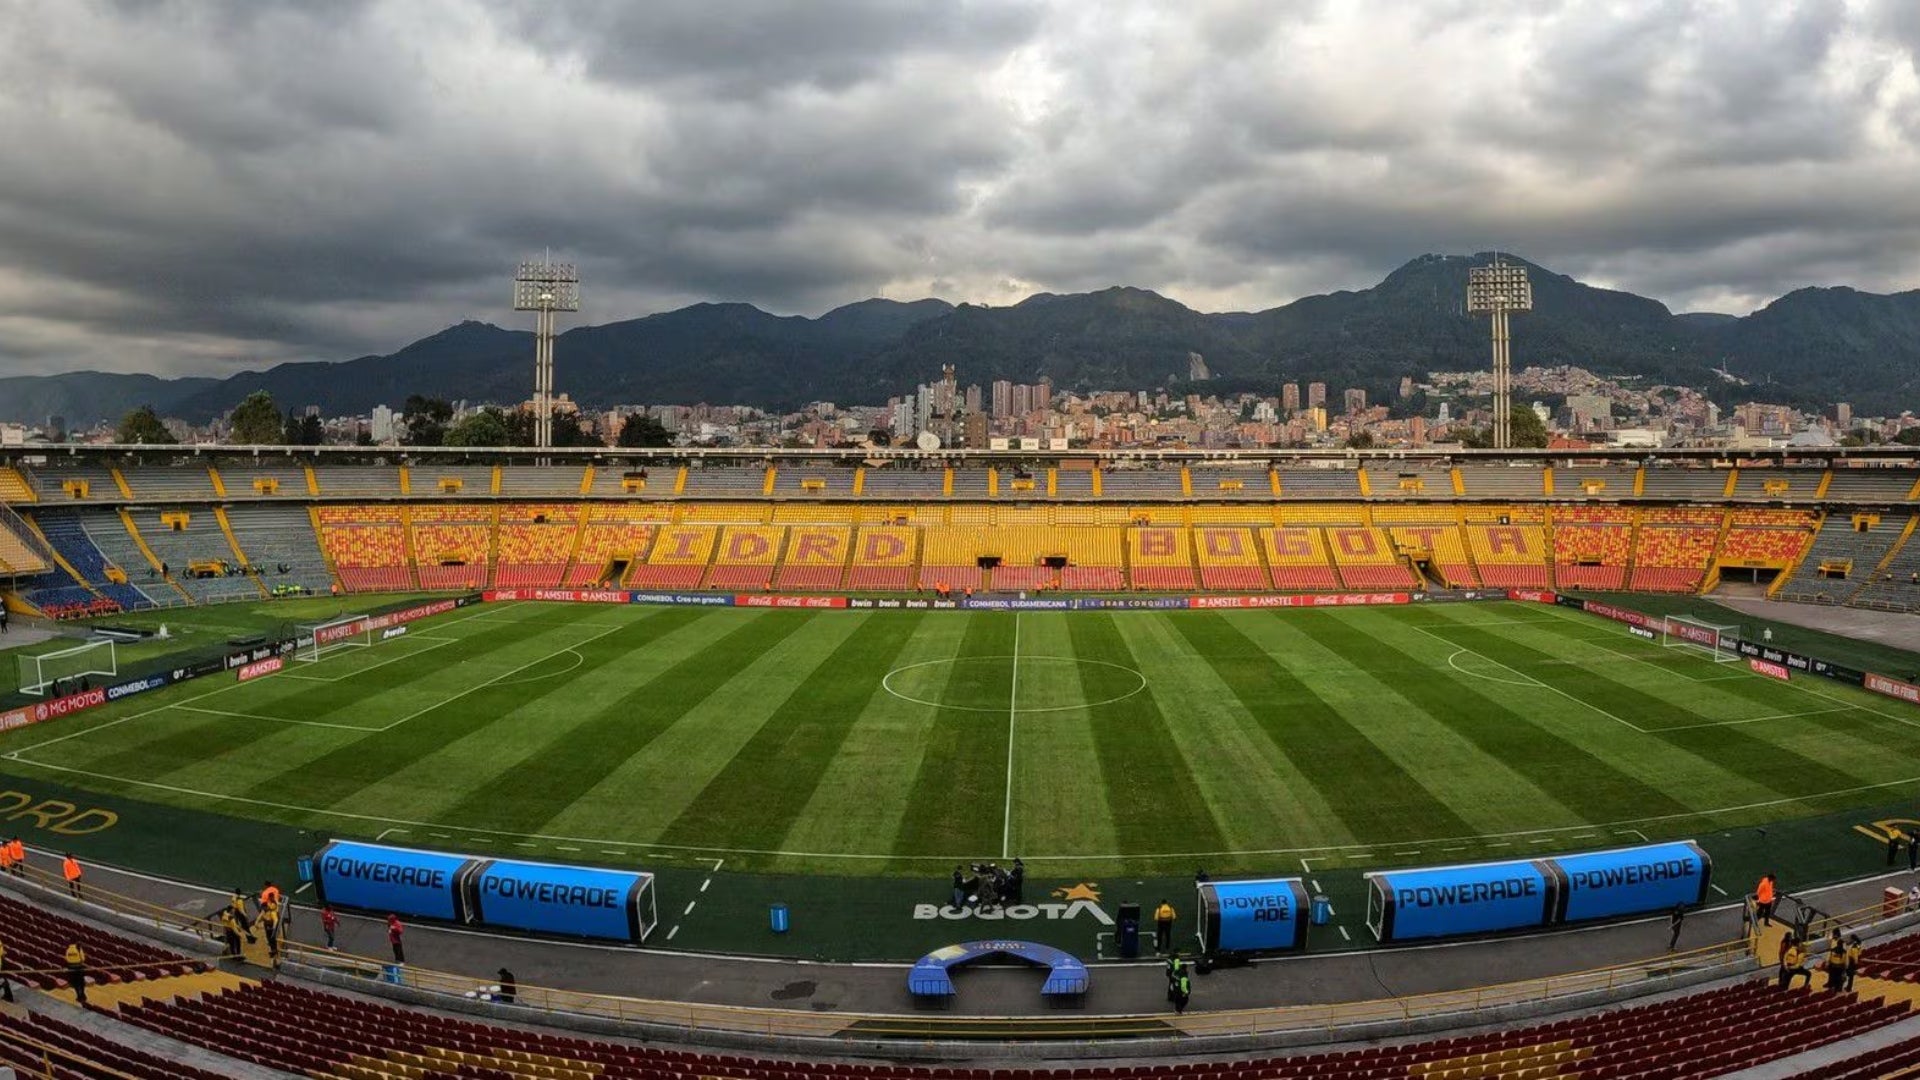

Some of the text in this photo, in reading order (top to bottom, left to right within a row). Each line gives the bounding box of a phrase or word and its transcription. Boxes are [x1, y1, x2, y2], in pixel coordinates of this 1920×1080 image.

[662, 532, 907, 561] IDRD
[1139, 530, 1529, 556] BOGOTA
[543, 591, 575, 600] AMSTEL
[588, 592, 622, 602] AMSTEL
[1207, 597, 1241, 607] AMSTEL
[1258, 597, 1292, 606] AMSTEL
[851, 599, 872, 608] bwin
[879, 599, 900, 608] bwin
[906, 599, 927, 608] bwin
[934, 599, 955, 608] bwin
[970, 600, 1067, 609] CONMEBOL SUDAMERICANA
[1100, 599, 1124, 607] GRAN
[328, 625, 353, 638] AMSTEL
[1630, 626, 1653, 638] bwin
[1688, 628, 1713, 644] AMSTEL
[249, 659, 281, 676] AMSTEL
[1758, 661, 1788, 680] AMSTEL
[108, 678, 164, 699] CONMEBOL.com
[50, 690, 105, 714] MG MOTOR
[326, 855, 444, 890] POWERADE
[1571, 857, 1696, 892] POWERADE
[483, 875, 618, 909] POWERADE
[1398, 877, 1538, 909] POWERADE
[1223, 895, 1288, 909] POWER
[1254, 907, 1291, 922] ADE
